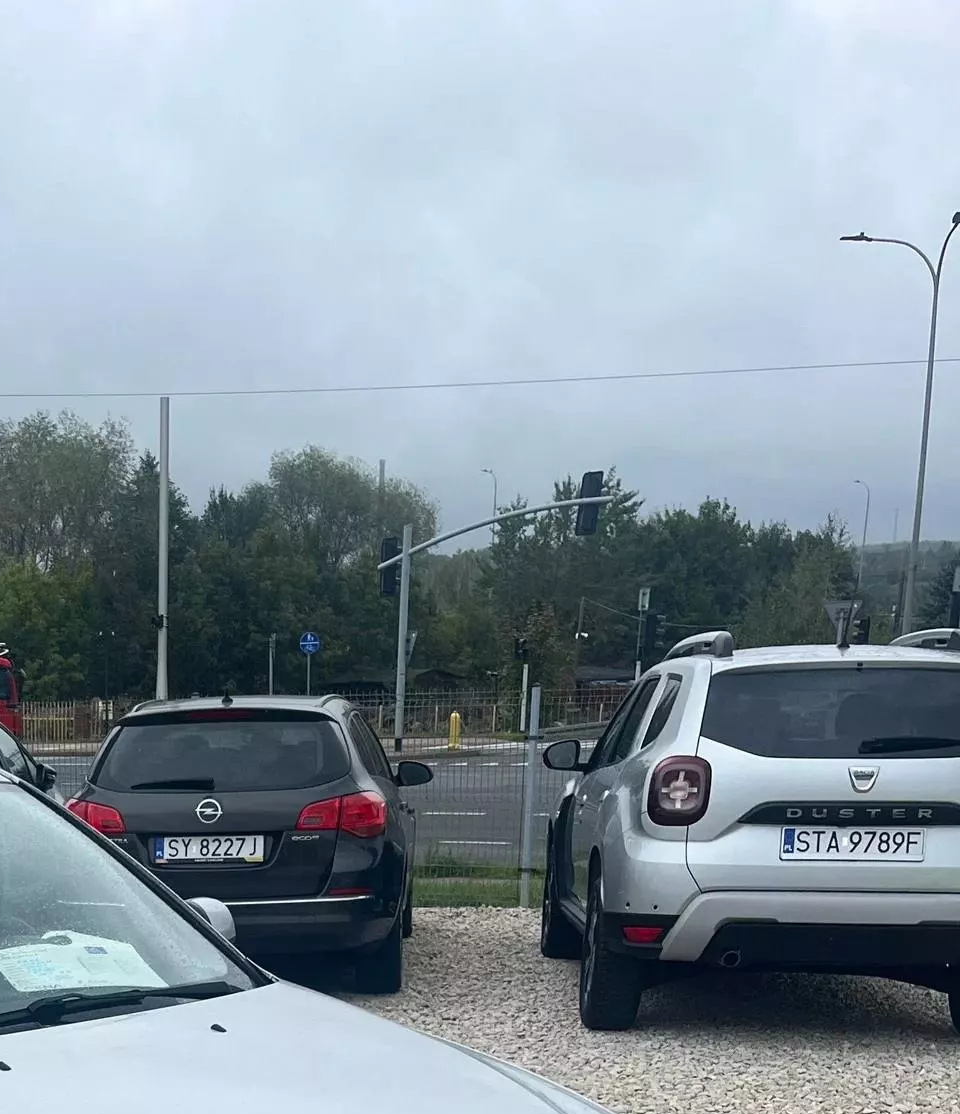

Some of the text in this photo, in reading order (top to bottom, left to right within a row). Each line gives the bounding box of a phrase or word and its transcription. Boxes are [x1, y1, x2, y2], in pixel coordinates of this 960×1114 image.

[786, 808, 934, 819] DUSTER
[168, 837, 257, 858] SY 8227J
[796, 831, 921, 854] STA 9789F
